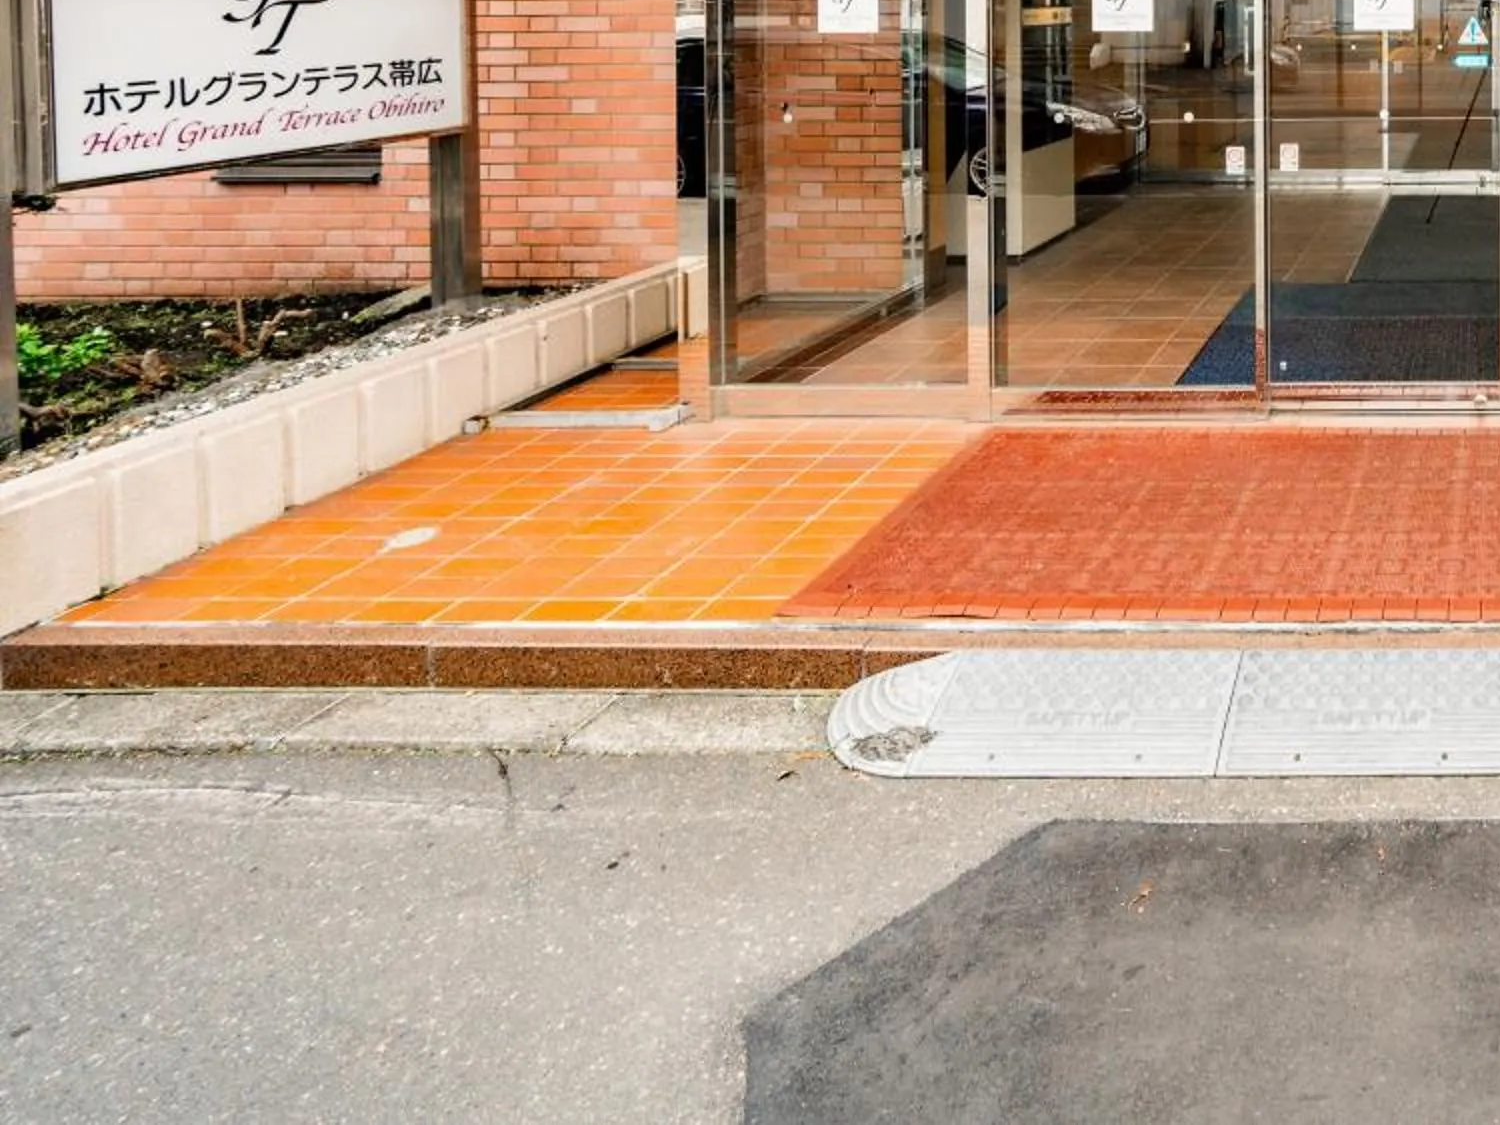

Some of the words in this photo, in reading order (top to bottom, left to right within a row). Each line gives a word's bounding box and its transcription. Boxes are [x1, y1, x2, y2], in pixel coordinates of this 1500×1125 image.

[83, 58, 443, 117] ホテルグランテラス帯広
[82, 119, 169, 156] Hotel
[177, 109, 270, 152] Grand
[279, 104, 361, 133] Terrace
[368, 92, 445, 122] Obihiro
